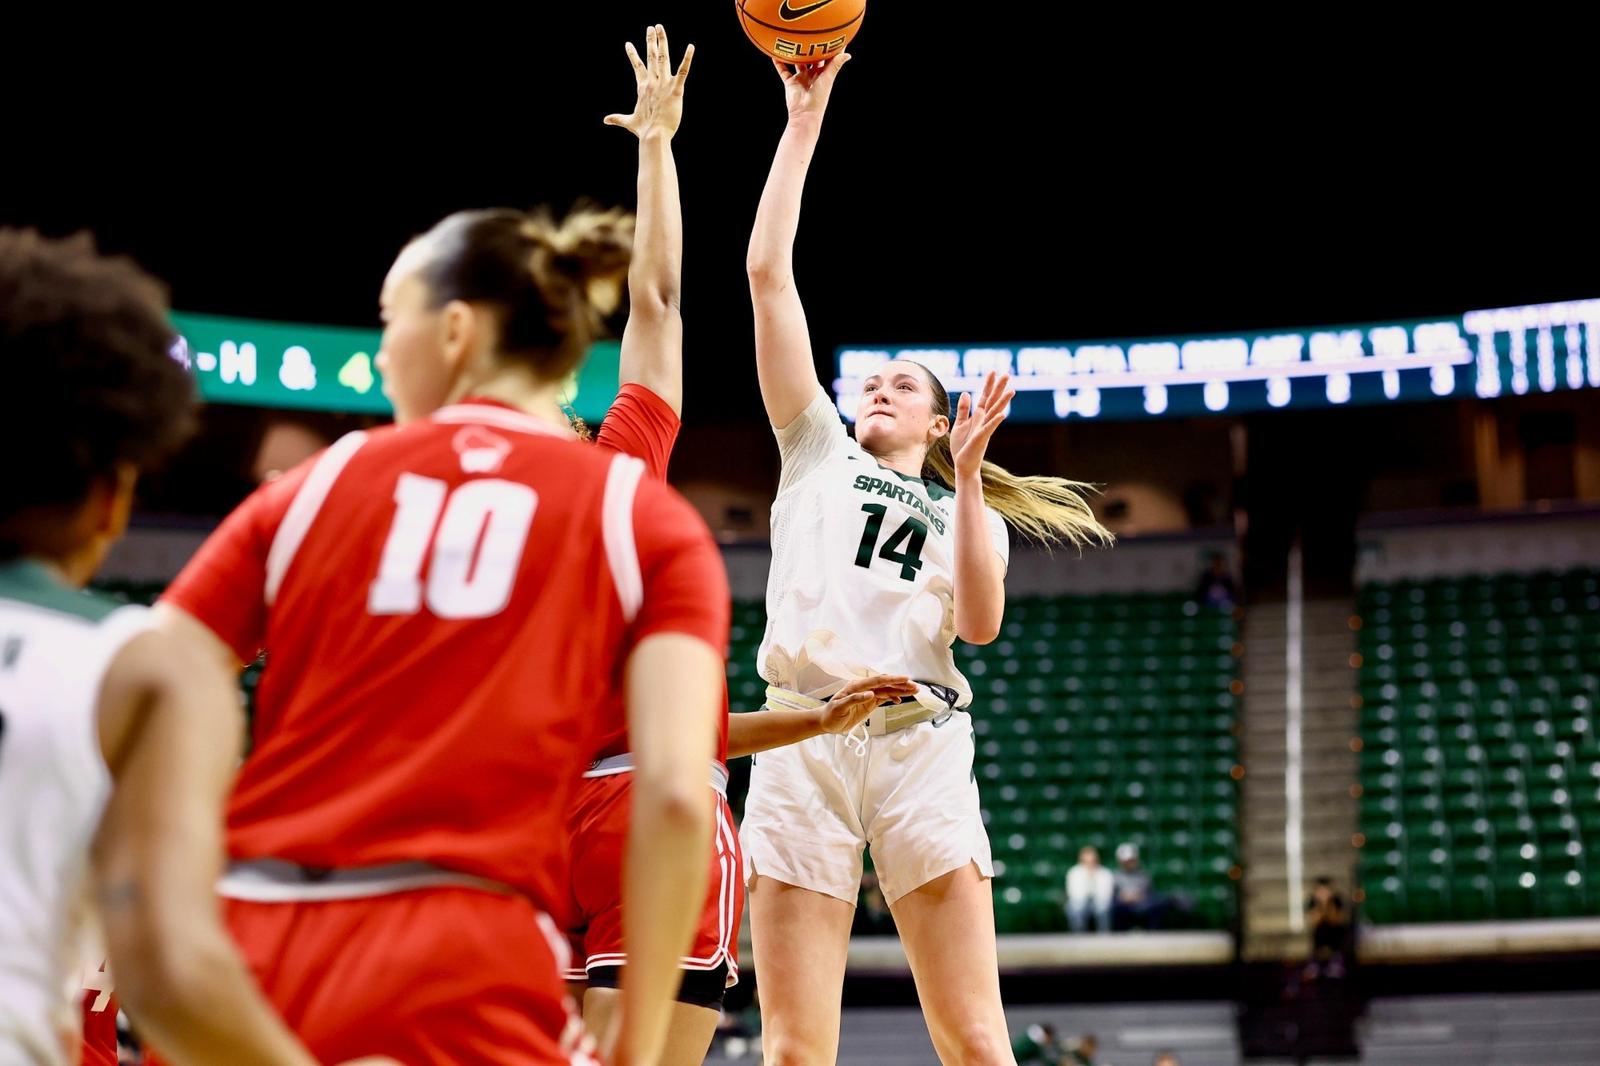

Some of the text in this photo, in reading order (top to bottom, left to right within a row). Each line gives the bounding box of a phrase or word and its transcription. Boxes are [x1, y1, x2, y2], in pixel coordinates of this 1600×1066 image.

[853, 474, 946, 536] SPARTANS
[854, 503, 928, 582] 14
[367, 471, 539, 621] 10
